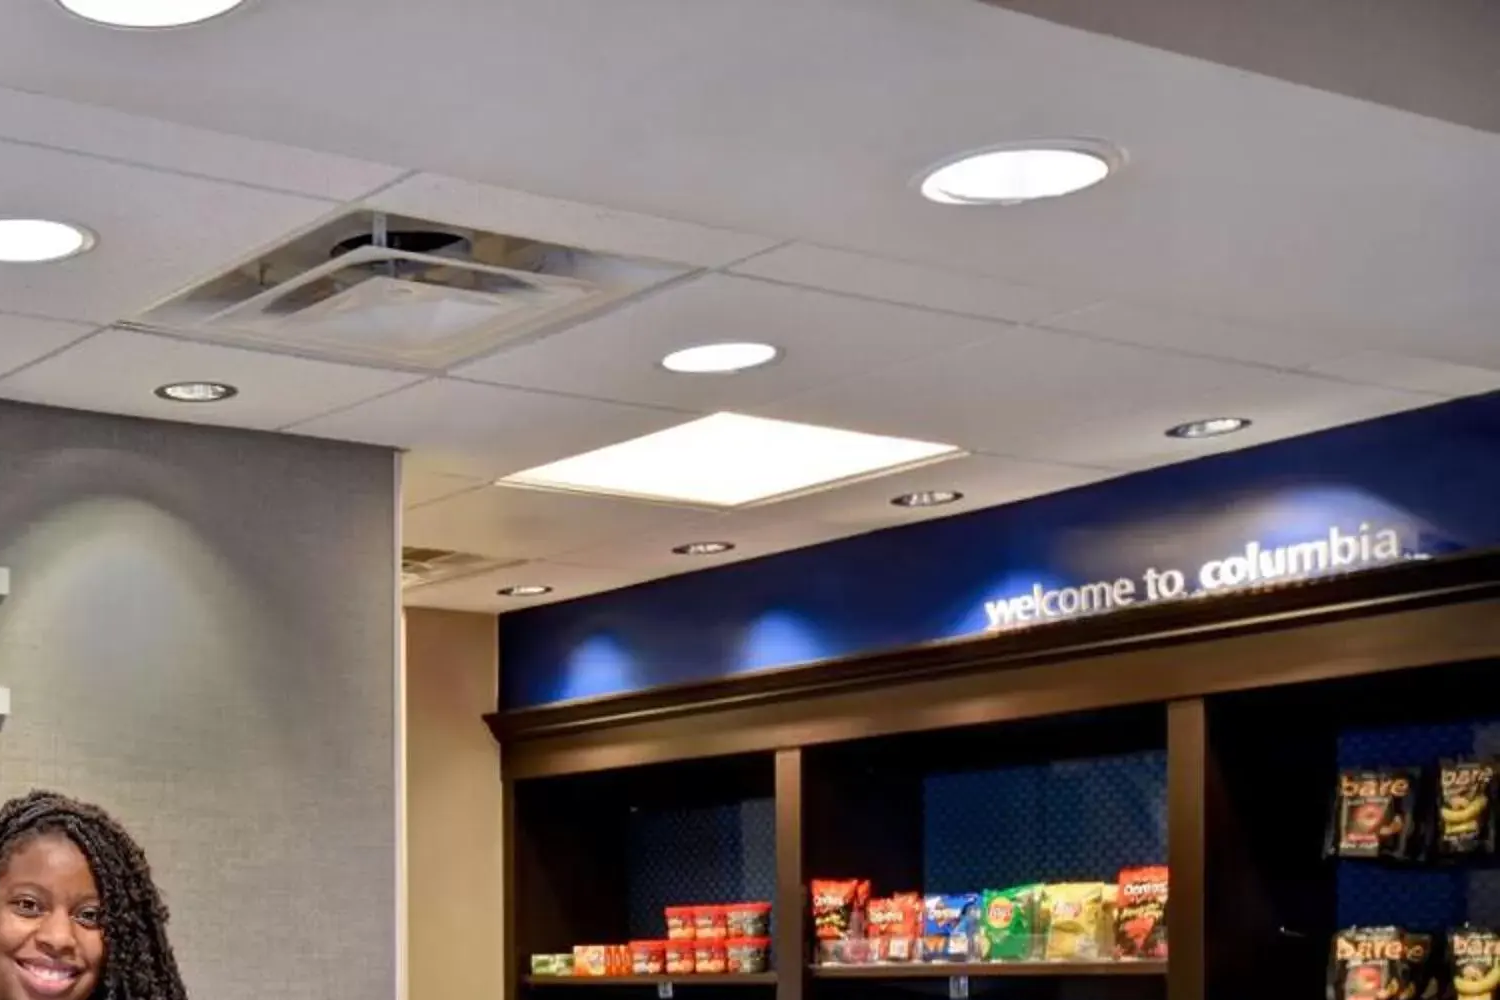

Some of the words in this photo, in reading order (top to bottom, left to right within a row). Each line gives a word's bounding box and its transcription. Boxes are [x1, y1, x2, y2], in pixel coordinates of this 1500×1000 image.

[984, 576, 1136, 627] welcome
[1143, 566, 1185, 601] to
[1340, 775, 1409, 797] bare
[1336, 936, 1402, 960] bare
